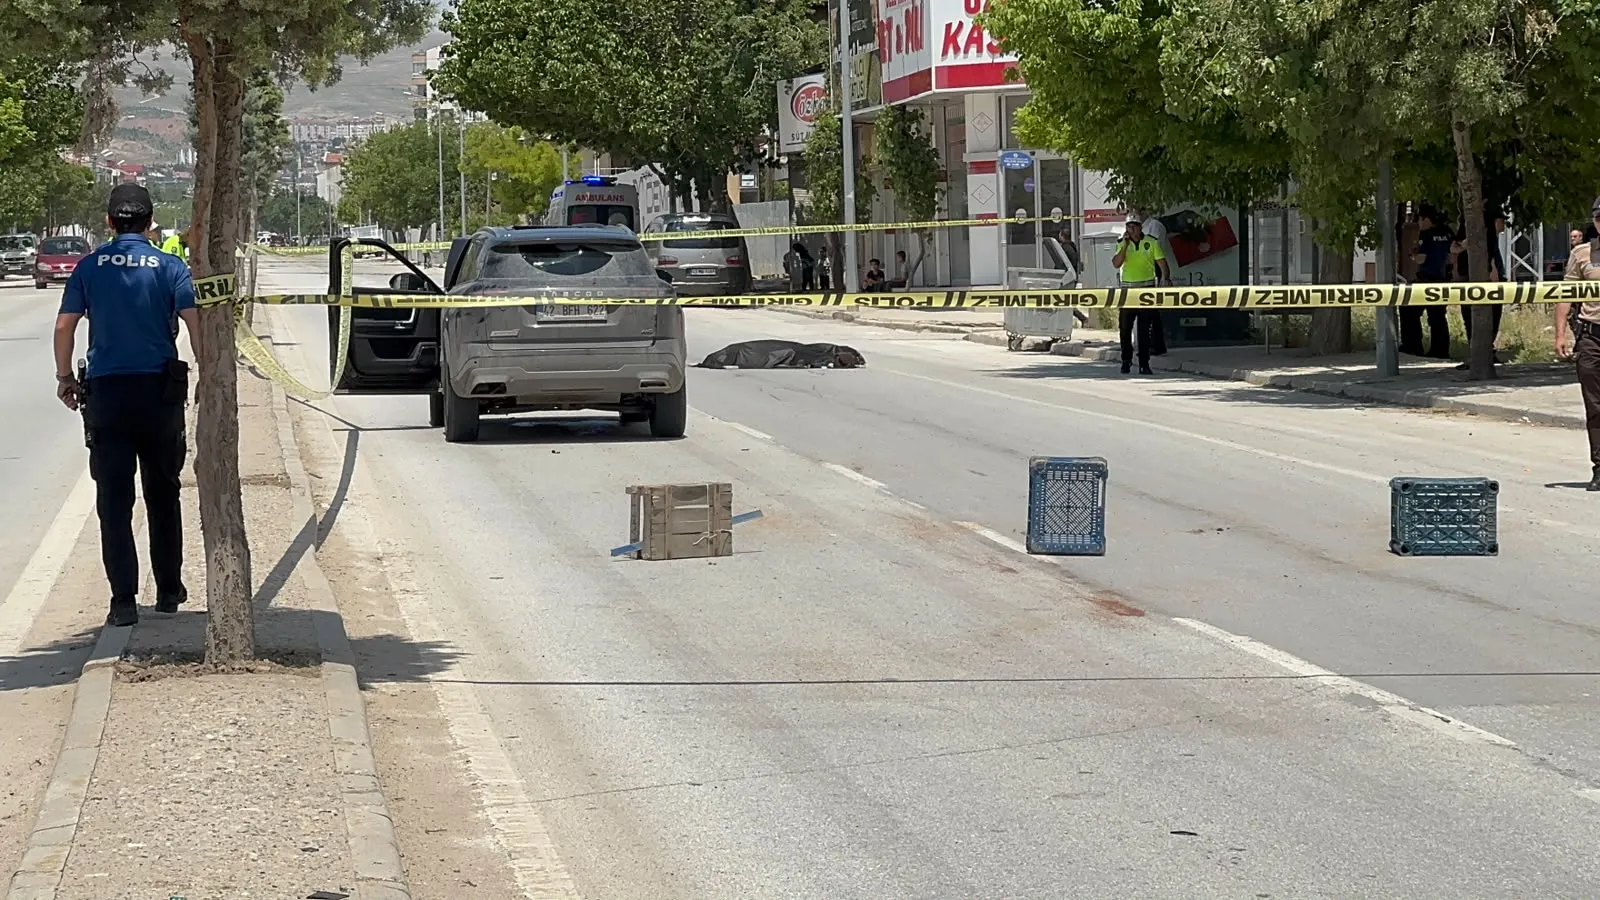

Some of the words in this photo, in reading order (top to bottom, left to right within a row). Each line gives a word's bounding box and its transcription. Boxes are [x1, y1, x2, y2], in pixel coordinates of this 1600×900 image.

[575, 193, 625, 202] AMBULANS
[562, 304, 580, 316] BFH
[587, 304, 605, 316] 622
